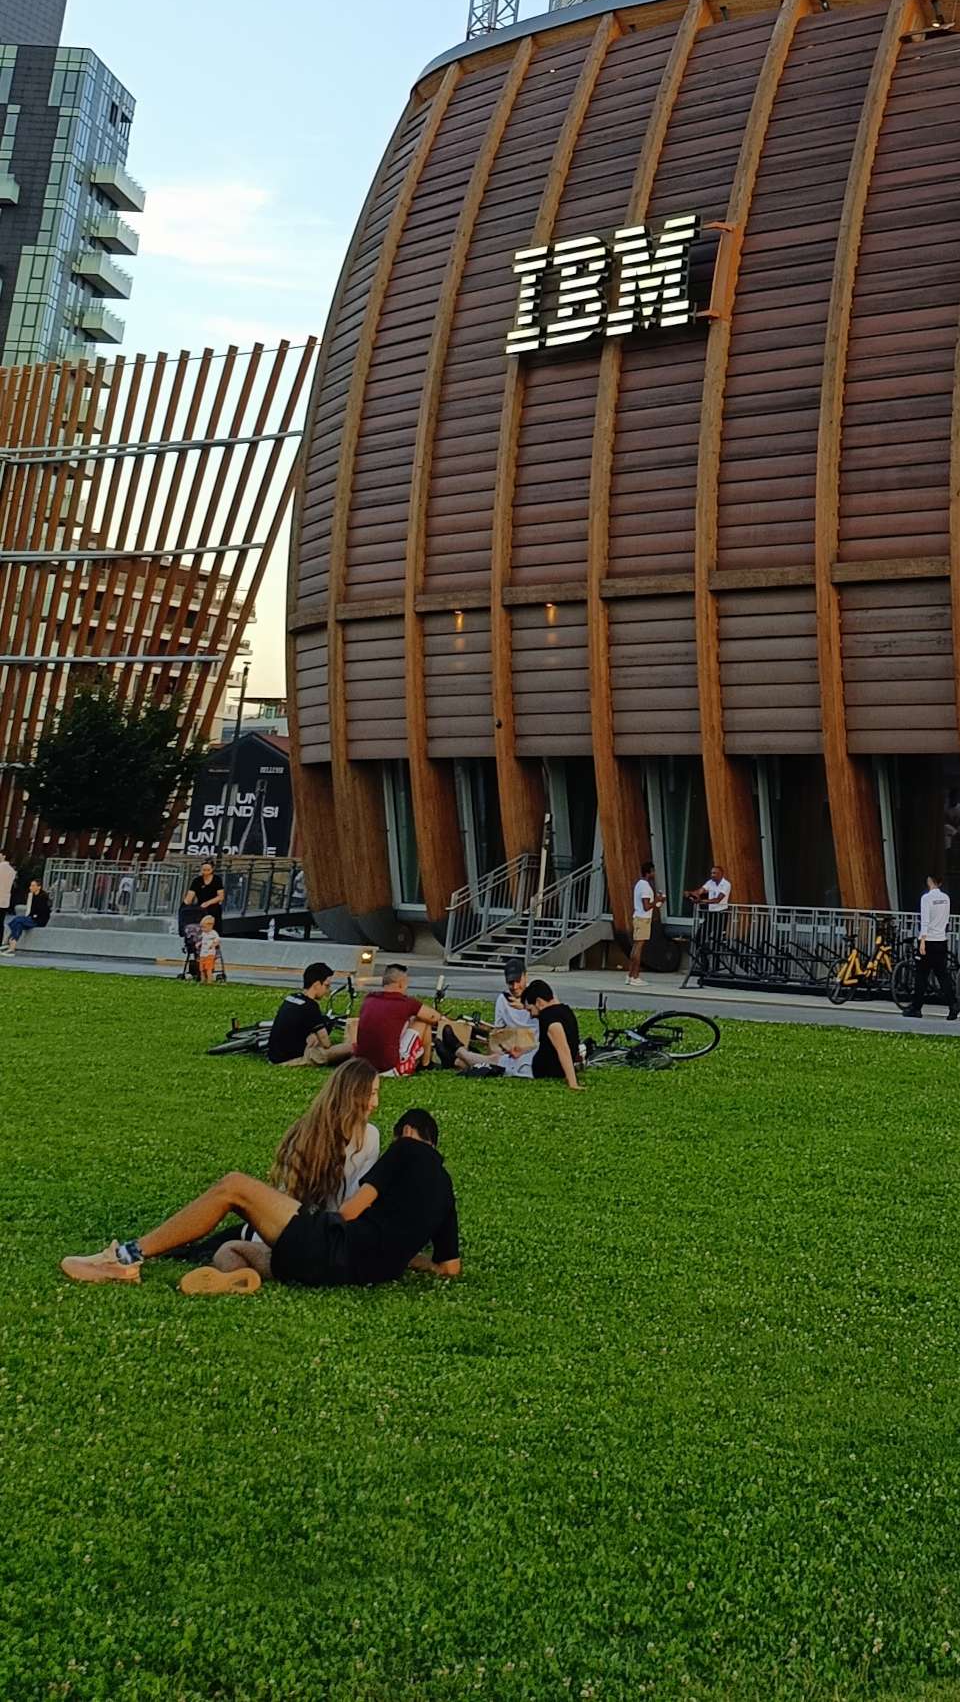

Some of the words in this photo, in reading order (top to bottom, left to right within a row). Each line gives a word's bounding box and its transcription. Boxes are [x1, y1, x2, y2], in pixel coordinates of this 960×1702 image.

[505, 214, 697, 354] IBM
[236, 792, 256, 804] UN
[204, 805, 279, 818] BRINDSI
[202, 818, 215, 830] A
[188, 831, 215, 843] UN
